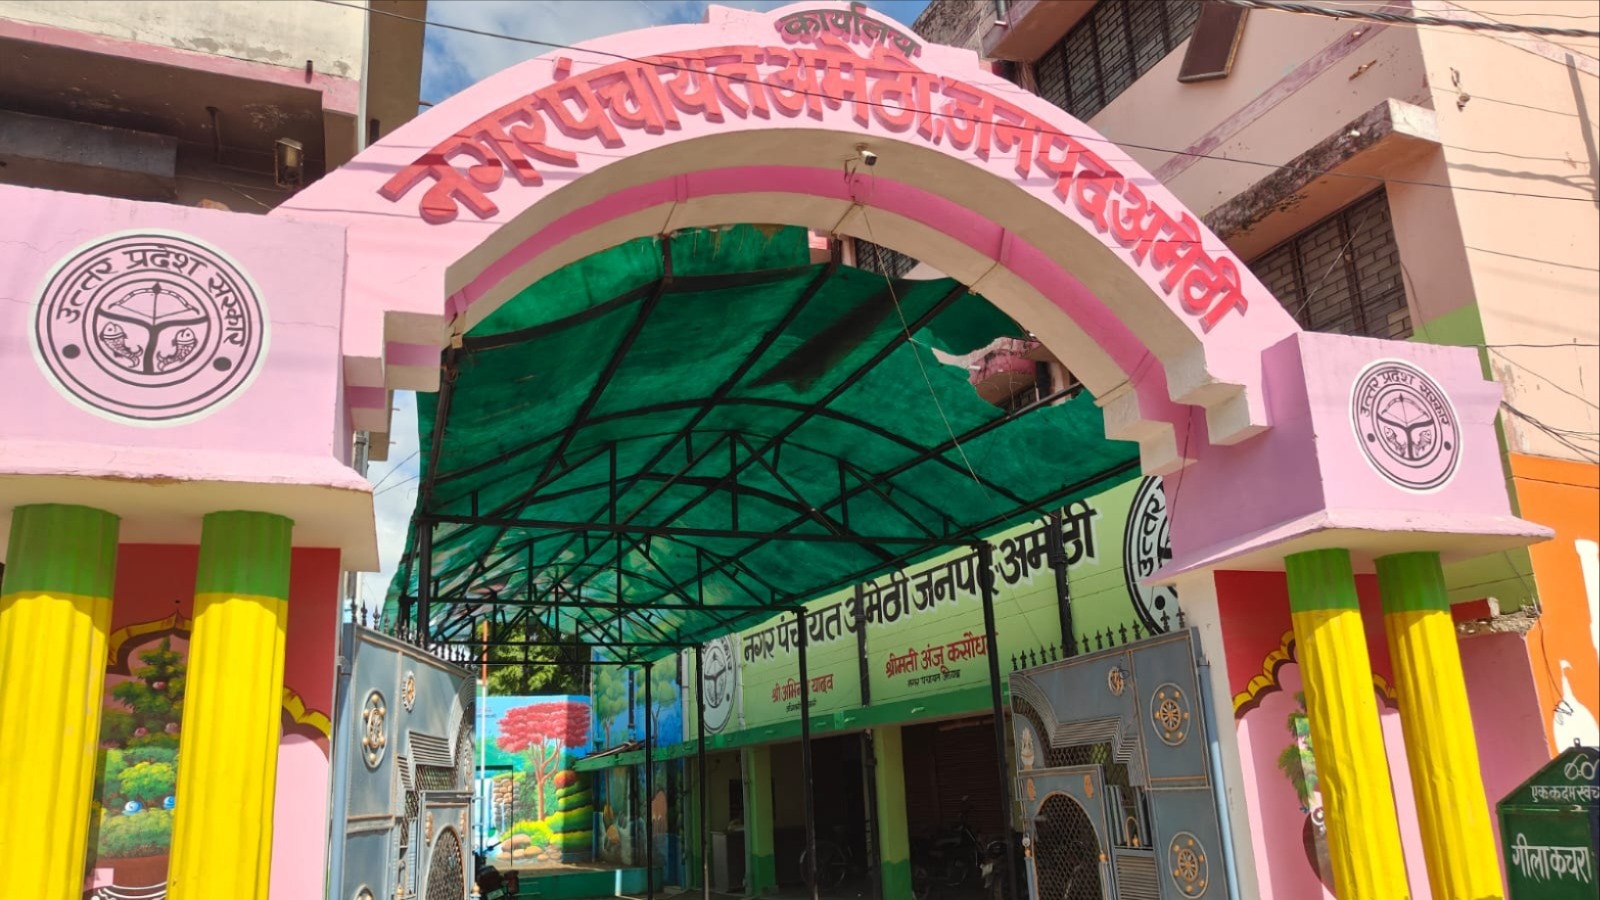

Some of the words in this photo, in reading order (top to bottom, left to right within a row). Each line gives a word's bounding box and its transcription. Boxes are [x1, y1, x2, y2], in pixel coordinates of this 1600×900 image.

[774, 2, 922, 58] कार्यालय
[377, 91, 579, 226] नगर
[530, 45, 771, 149] पंचायत
[938, 76, 1124, 234] जनपद
[1107, 180, 1249, 335] अमेठी
[57, 256, 119, 324] उत्तर
[121, 245, 208, 276] प्रदेश
[208, 272, 245, 347] सरकार
[743, 627, 775, 663] नगर
[1511, 833, 1551, 883] गीला
[1550, 846, 1593, 884] कचरा
